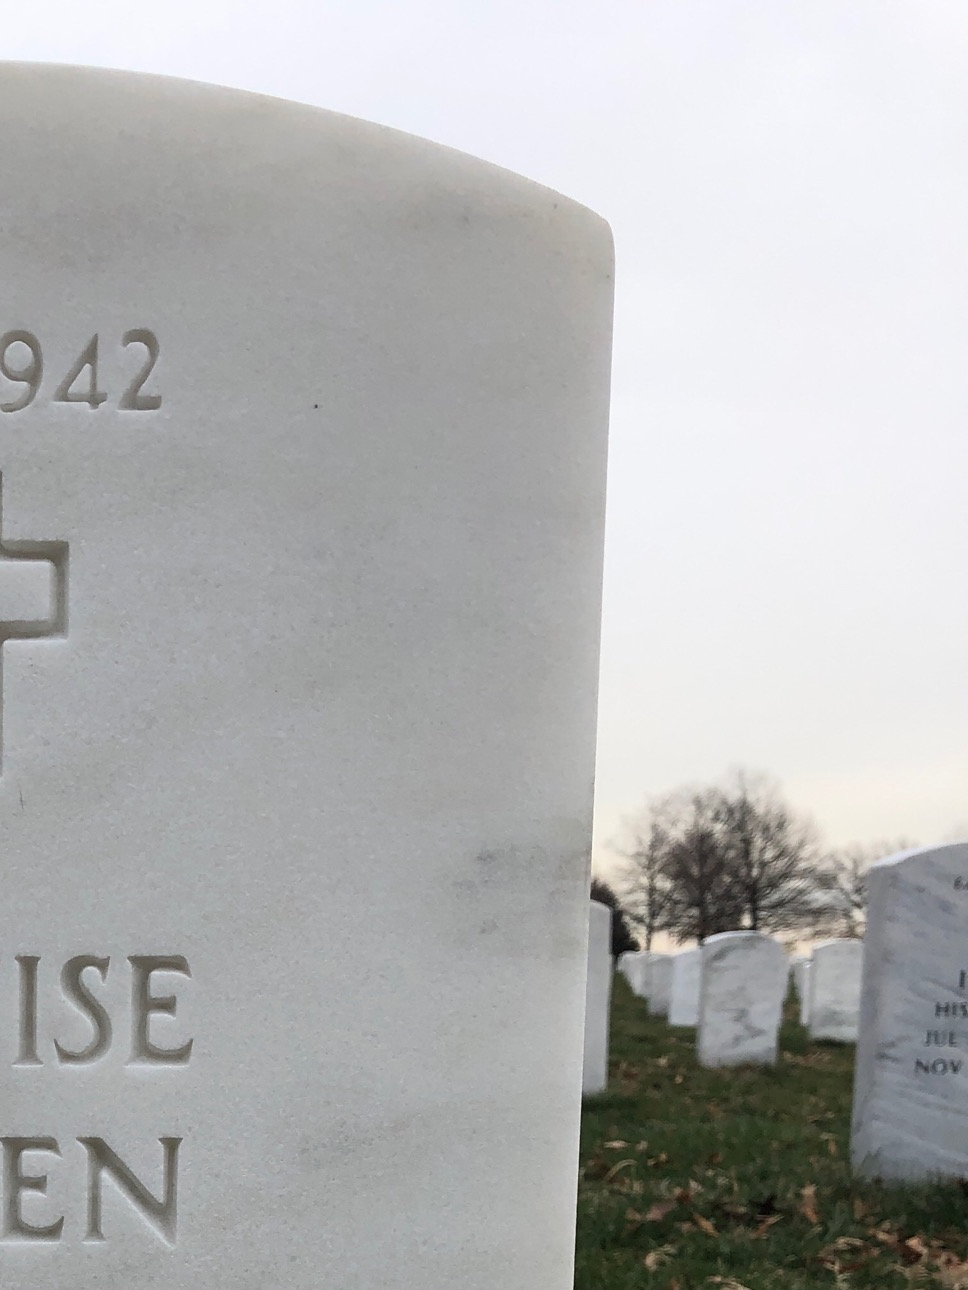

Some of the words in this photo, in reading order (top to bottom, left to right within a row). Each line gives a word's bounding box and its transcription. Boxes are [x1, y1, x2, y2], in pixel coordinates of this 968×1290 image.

[935, 1001, 968, 1018] HIS
[924, 1029, 958, 1047] JUL
[914, 1057, 962, 1076] NOV
